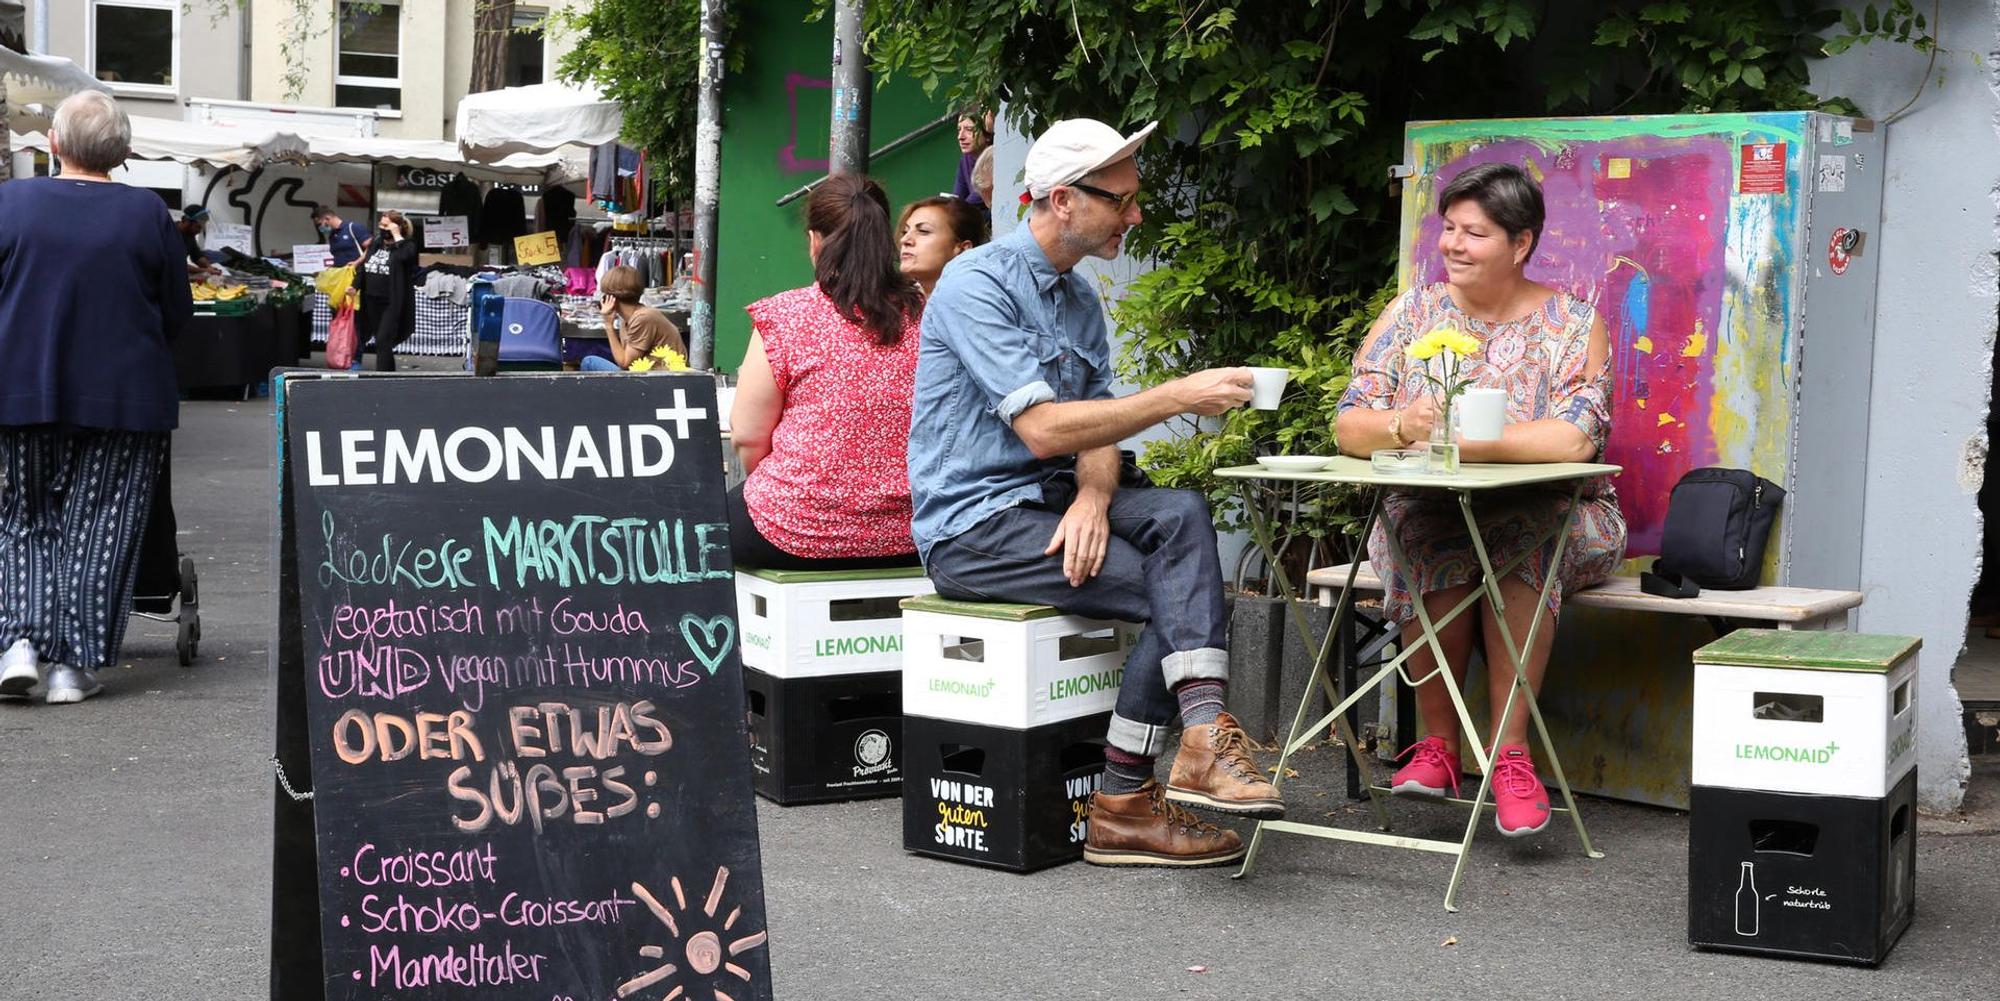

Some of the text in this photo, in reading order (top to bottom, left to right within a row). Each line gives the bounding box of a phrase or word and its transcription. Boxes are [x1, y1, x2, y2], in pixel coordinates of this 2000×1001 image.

[318, 510, 733, 591] Leckere MARKTSTULLE
[496, 596, 544, 635] mit
[550, 597, 650, 635] Gouda
[815, 634, 903, 658] LEMONAI
[319, 642, 701, 713] UND vegan mit Hummus
[333, 700, 673, 765] ODER ETWAS
[930, 777, 961, 803] VON
[964, 783, 994, 809] DER
[1065, 775, 1092, 800] VON
[938, 801, 988, 833] guten
[935, 824, 989, 852] SORTE.
[354, 842, 498, 888] Croissant
[1783, 898, 1832, 911] naturtrüb
[1786, 885, 1828, 898] Schorle
[361, 888, 637, 933] Schoko-Croissant
[370, 938, 548, 989] Mandeltaler
